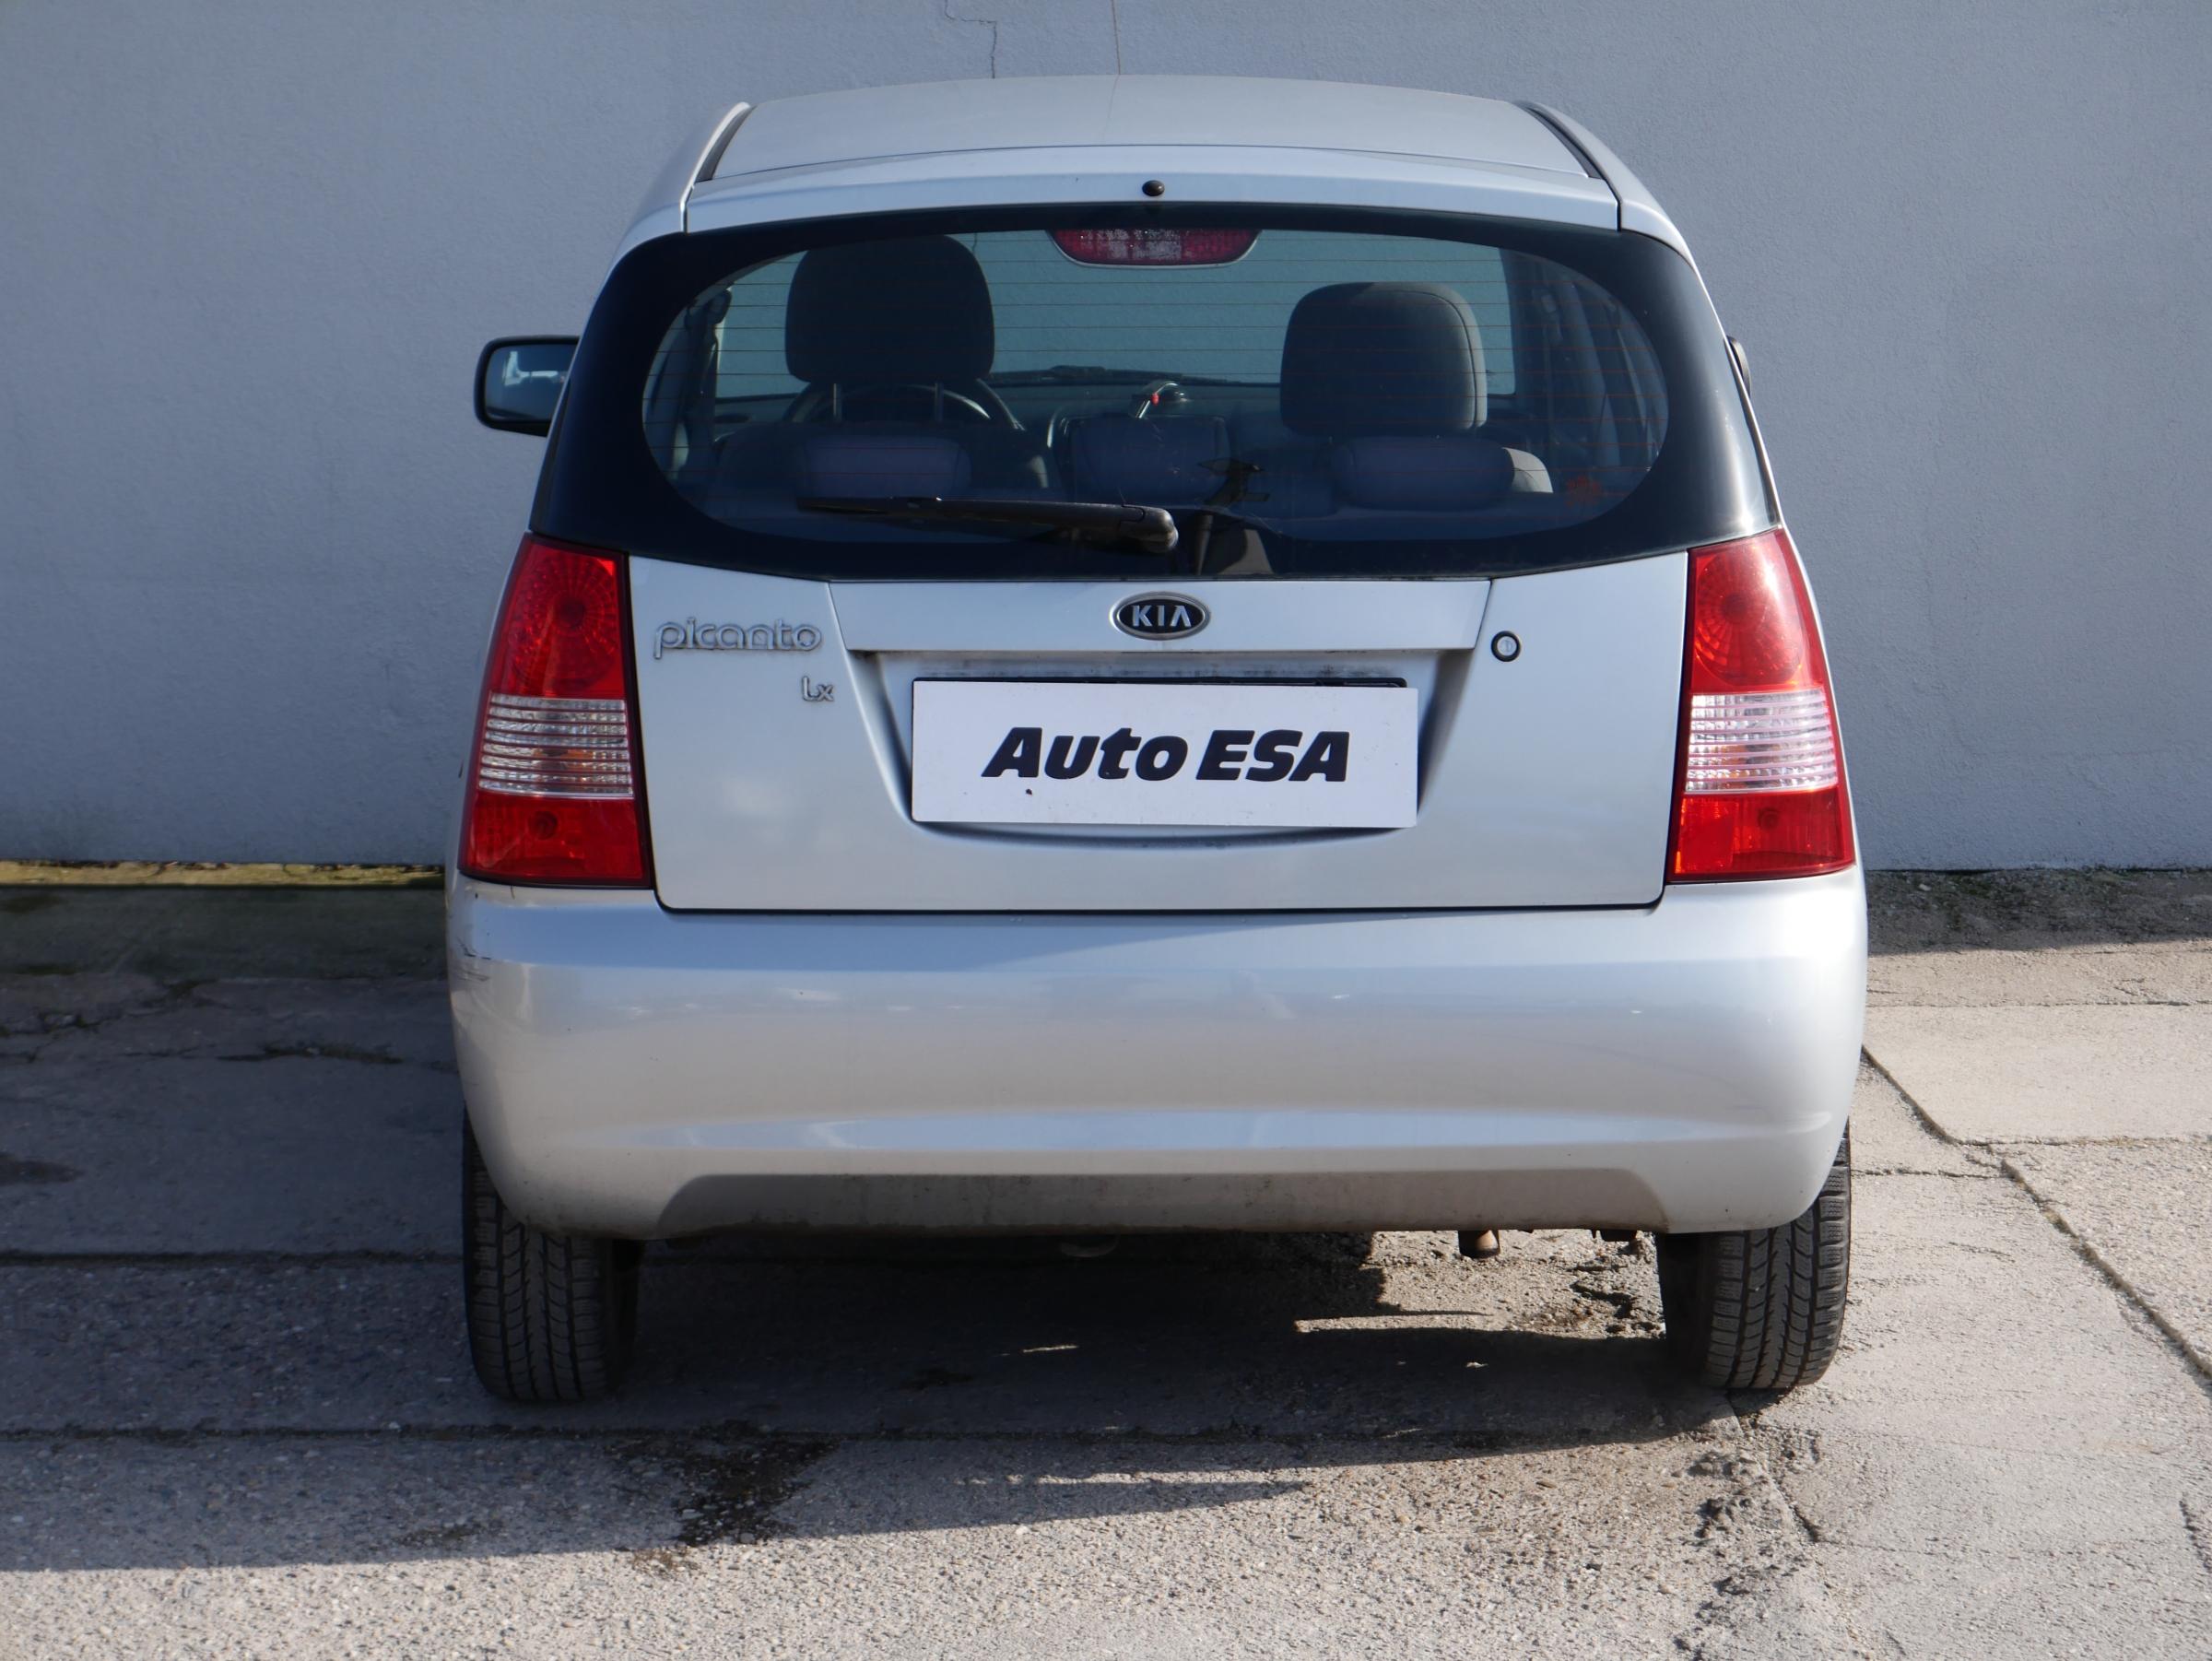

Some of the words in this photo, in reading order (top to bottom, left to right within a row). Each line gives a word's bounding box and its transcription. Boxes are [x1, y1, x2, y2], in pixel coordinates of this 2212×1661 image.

[1132, 605, 1192, 627] KIA
[653, 617, 822, 659] picanto
[981, 726, 1188, 781] Auto
[1195, 729, 1350, 782] ESA
